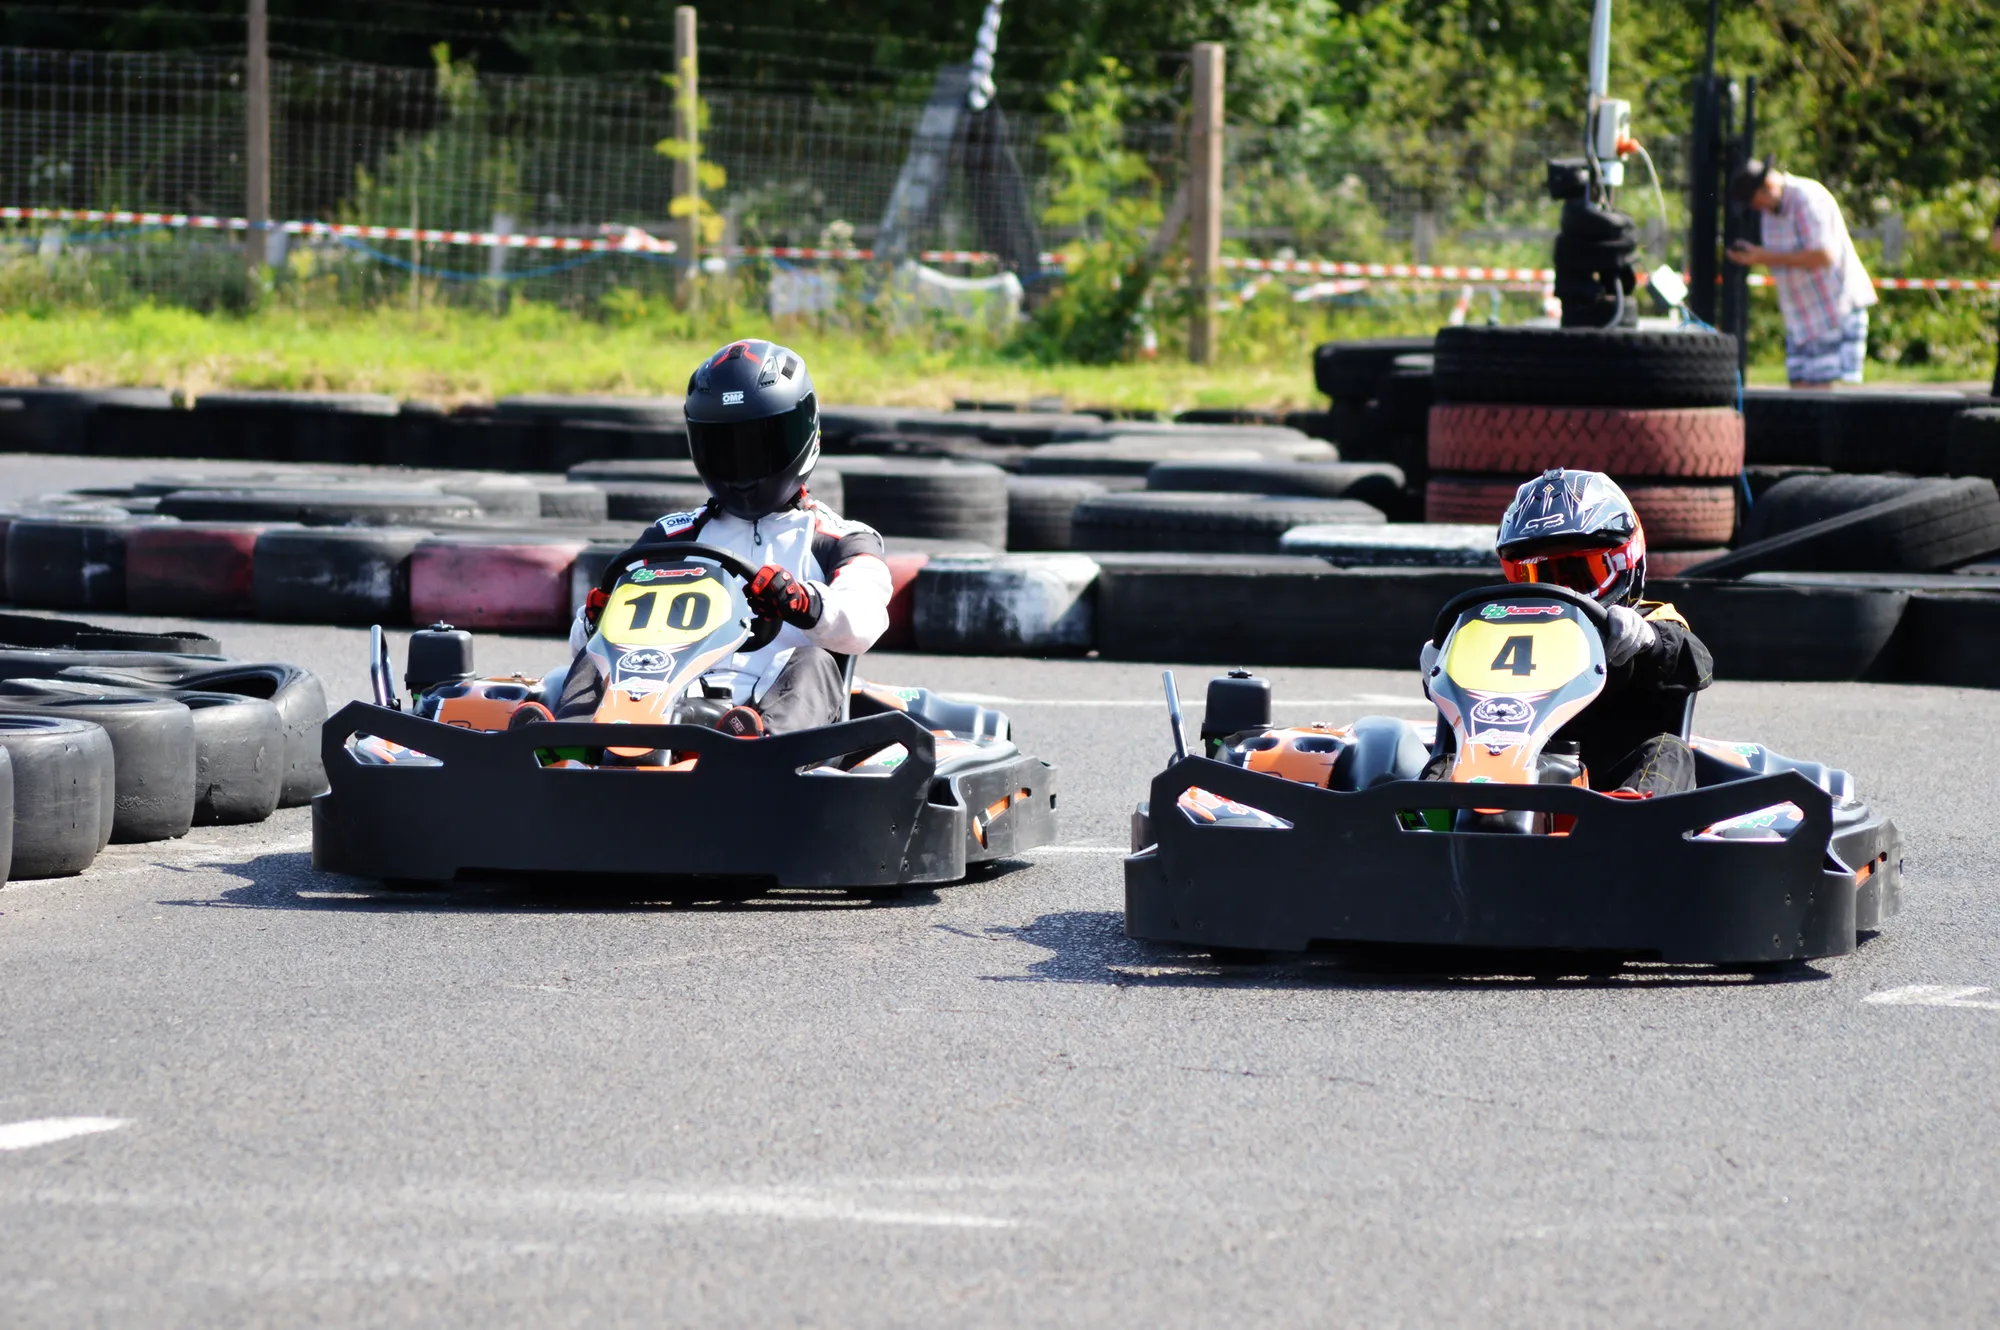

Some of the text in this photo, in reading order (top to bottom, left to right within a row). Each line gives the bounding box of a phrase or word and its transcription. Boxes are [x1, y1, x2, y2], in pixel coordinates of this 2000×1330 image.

[723, 393, 744, 403] OMP
[624, 591, 711, 631] 10
[1490, 635, 1537, 676] 4
[1486, 703, 1518, 714] MK
